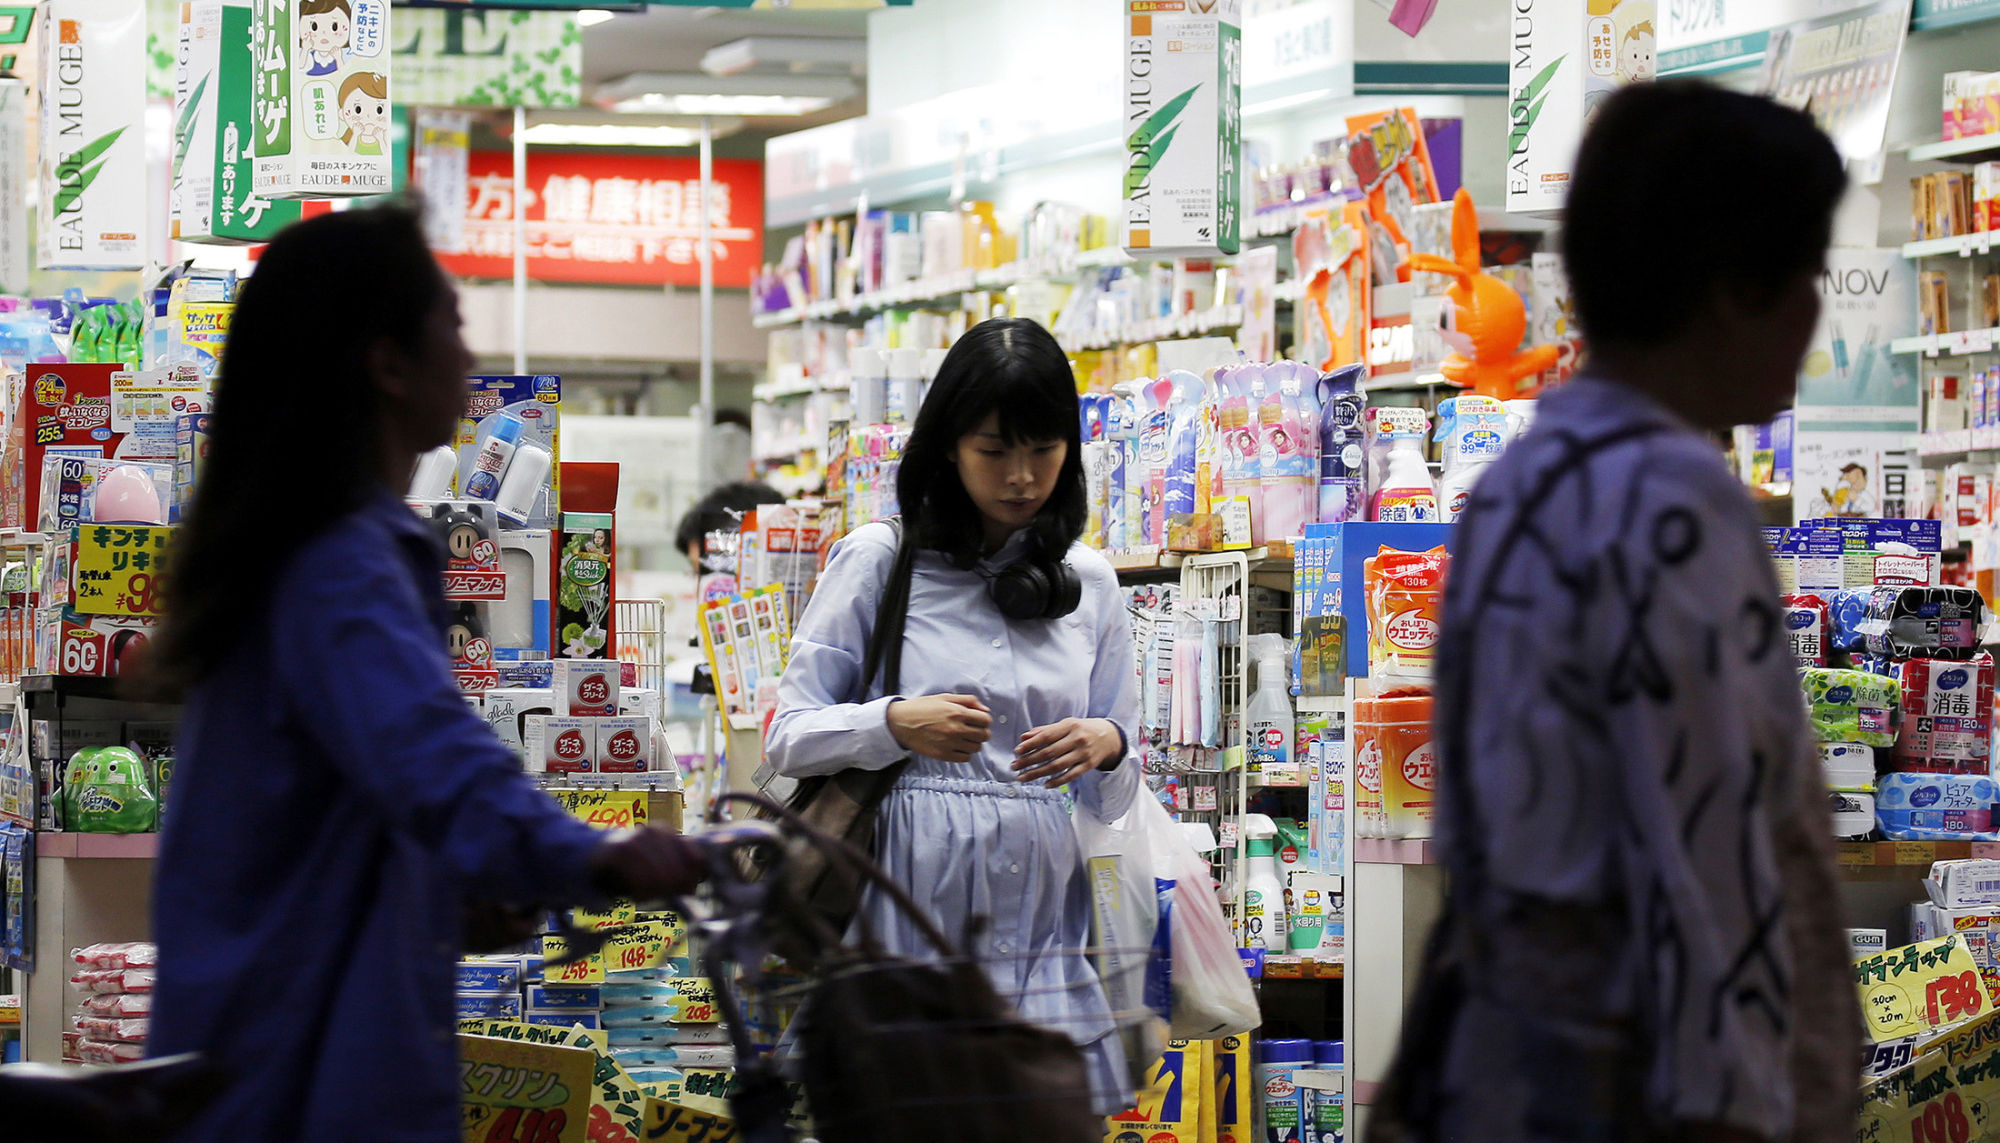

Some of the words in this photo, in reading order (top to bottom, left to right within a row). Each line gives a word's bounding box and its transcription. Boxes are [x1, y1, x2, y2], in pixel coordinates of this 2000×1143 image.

[368, 5, 380, 48] ニキビの
[1129, 39, 1152, 121] MUGE
[59, 44, 83, 137] MUGE
[312, 87, 327, 134] 肌あれに
[1510, 86, 1532, 197] EAUDE
[311, 161, 377, 171] 毎日のスキンケアに
[301, 174, 340, 186] EAUDE
[352, 174, 387, 187] MUGE
[1129, 131, 1151, 225] EAUDE
[59, 151, 83, 251] EAUDE
[220, 164, 236, 226] あります
[1822, 268, 1890, 296] NOV
[62, 461, 82, 479] 60
[61, 494, 79, 504] 水性
[1379, 507, 1407, 522] 除菌
[473, 543, 494, 561] 60
[1403, 577, 1429, 587] 130枚
[1400, 619, 1428, 628] おしぼり
[1388, 626, 1440, 641] ウエッティー
[63, 637, 98, 674] 60
[466, 642, 487, 658] 60
[583, 682, 605, 692] ザーネ
[1856, 686, 1880, 702] 除菌
[583, 691, 605, 699] クリーム
[1932, 691, 1971, 717] 消毒
[560, 737, 581, 747] ザーネ
[613, 738, 635, 748] ザーネ
[560, 746, 581, 754] クリーム
[613, 747, 636, 755] クリーム
[1913, 791, 1938, 799] シルコット
[1946, 784, 1971, 797] ピュア
[1943, 796, 1977, 809] ウォーター
[1851, 935, 1957, 986] サランラップ
[1871, 994, 1897, 1007] 30cm
[1878, 1012, 1904, 1024] 20m
